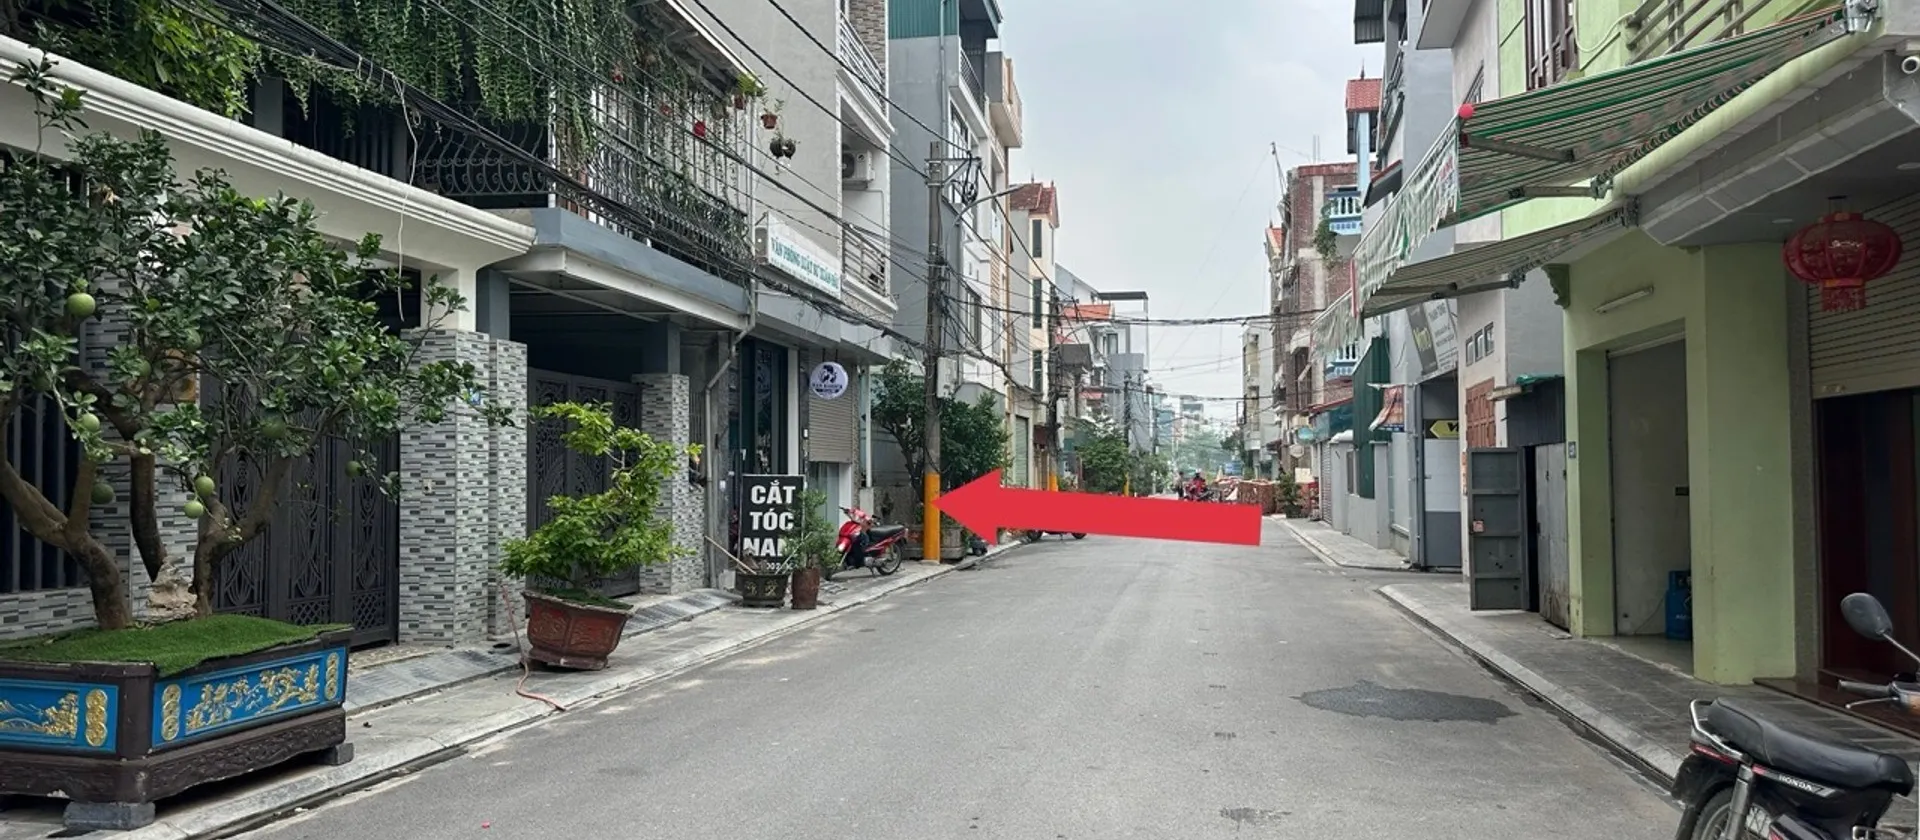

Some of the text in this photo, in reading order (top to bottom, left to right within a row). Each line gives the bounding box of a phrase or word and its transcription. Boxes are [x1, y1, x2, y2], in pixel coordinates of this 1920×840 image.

[751, 479, 796, 505] CẮT
[749, 507, 794, 531] TÓC
[1778, 774, 1812, 791] HONDA
